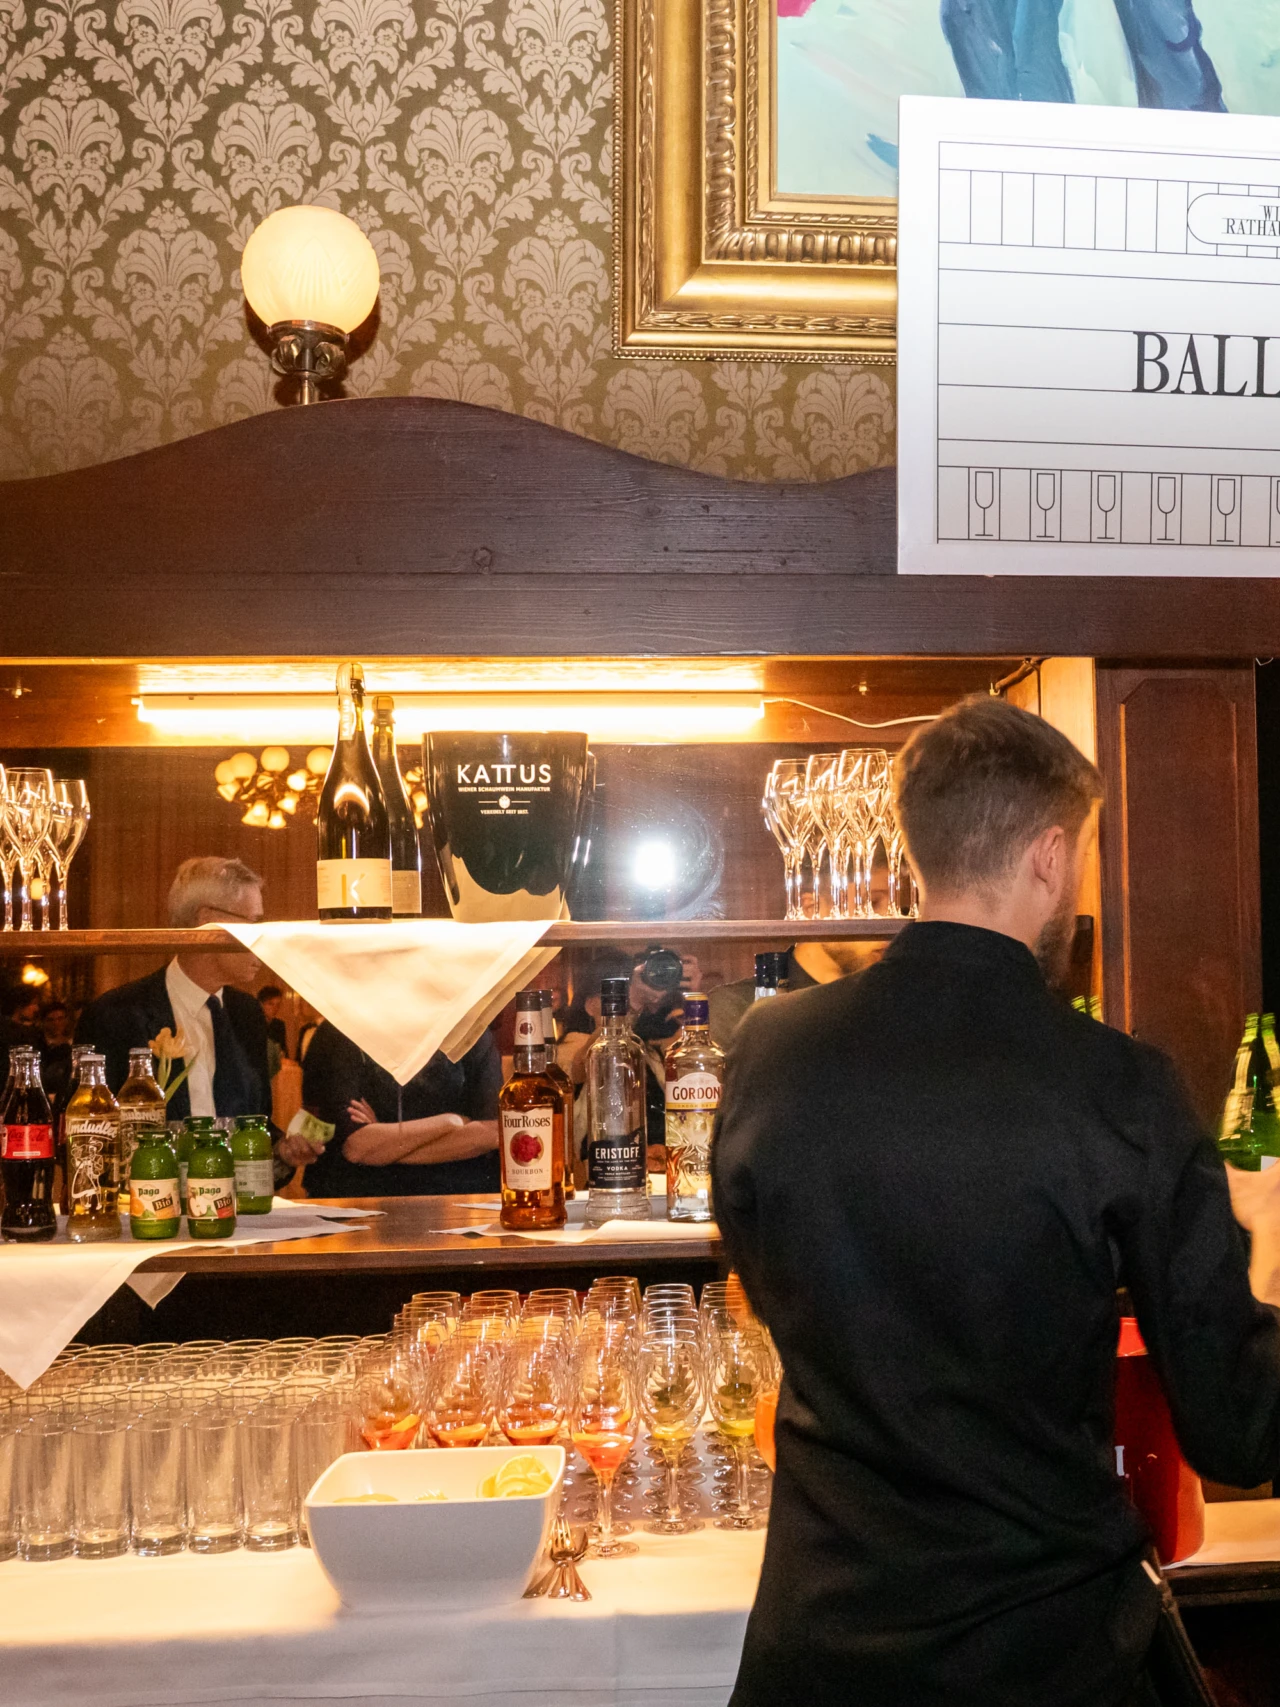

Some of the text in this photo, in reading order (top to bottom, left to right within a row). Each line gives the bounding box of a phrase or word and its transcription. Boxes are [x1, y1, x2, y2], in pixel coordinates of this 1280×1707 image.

[457, 764, 552, 784] KATTUS
[672, 1086, 722, 1101] GORDON
[595, 1146, 640, 1160] ERISTOFF
[155, 1199, 172, 1211] Bio
[216, 1198, 232, 1210] Bio
